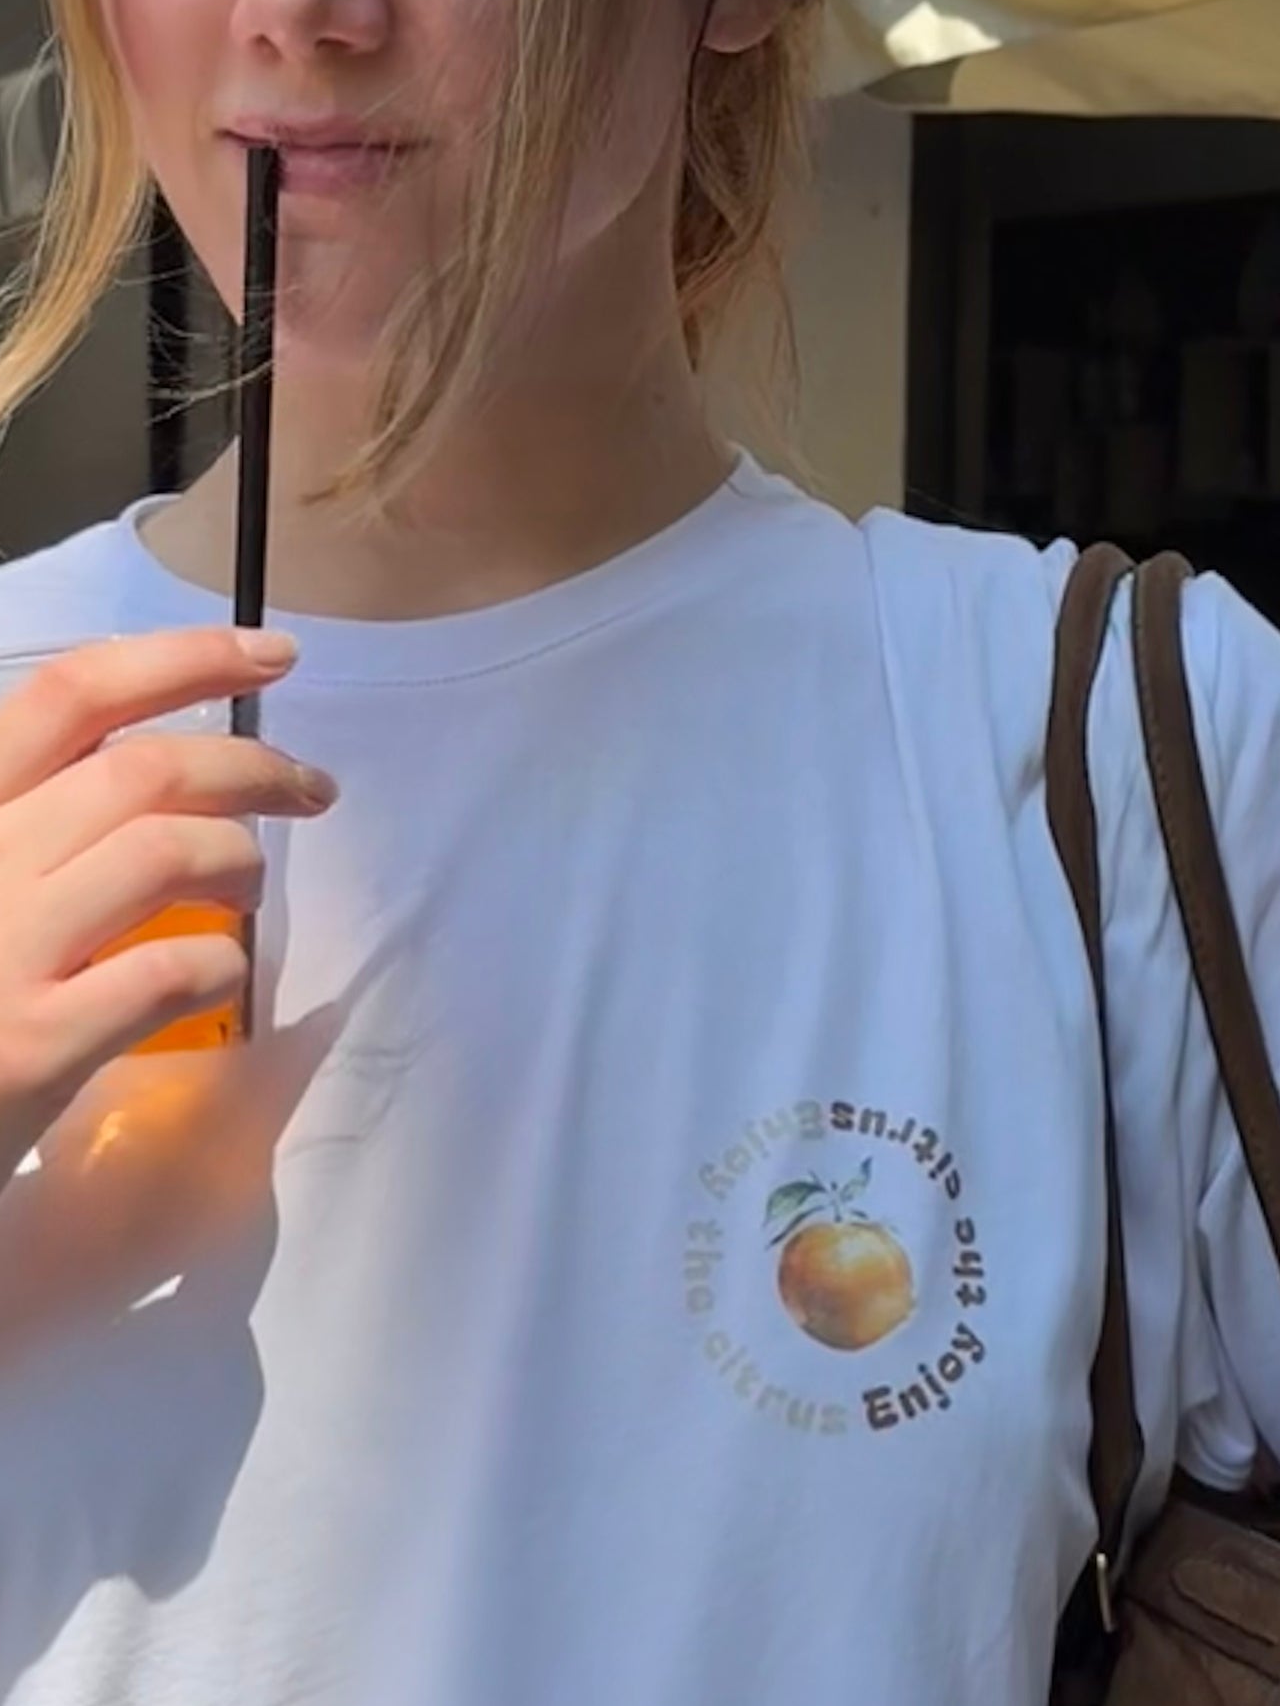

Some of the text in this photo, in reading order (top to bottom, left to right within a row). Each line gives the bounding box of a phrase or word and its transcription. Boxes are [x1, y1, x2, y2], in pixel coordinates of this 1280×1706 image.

[828, 1098, 987, 1432] Enjoy the citrus
